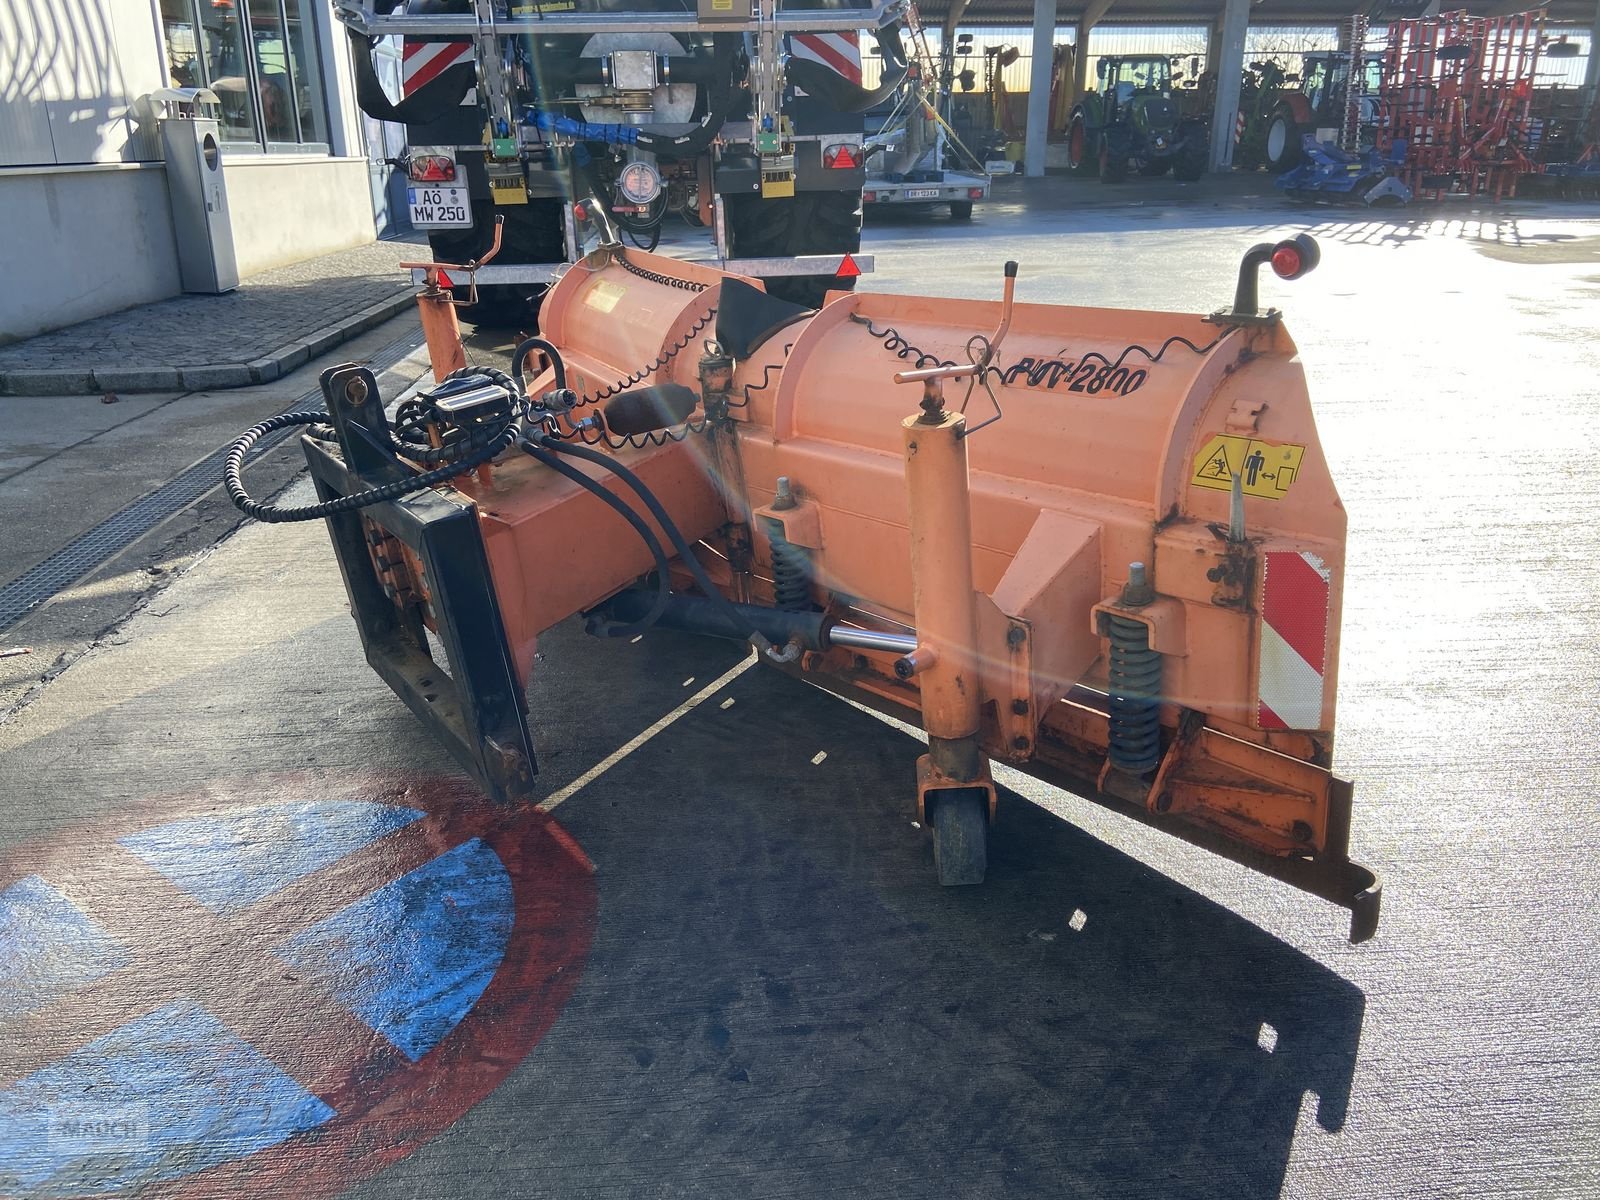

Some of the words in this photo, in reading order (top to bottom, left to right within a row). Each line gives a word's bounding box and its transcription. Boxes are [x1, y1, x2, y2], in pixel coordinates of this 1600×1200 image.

[423, 190, 442, 205] AÖ
[414, 206, 434, 221] MW
[437, 206, 466, 221] 250
